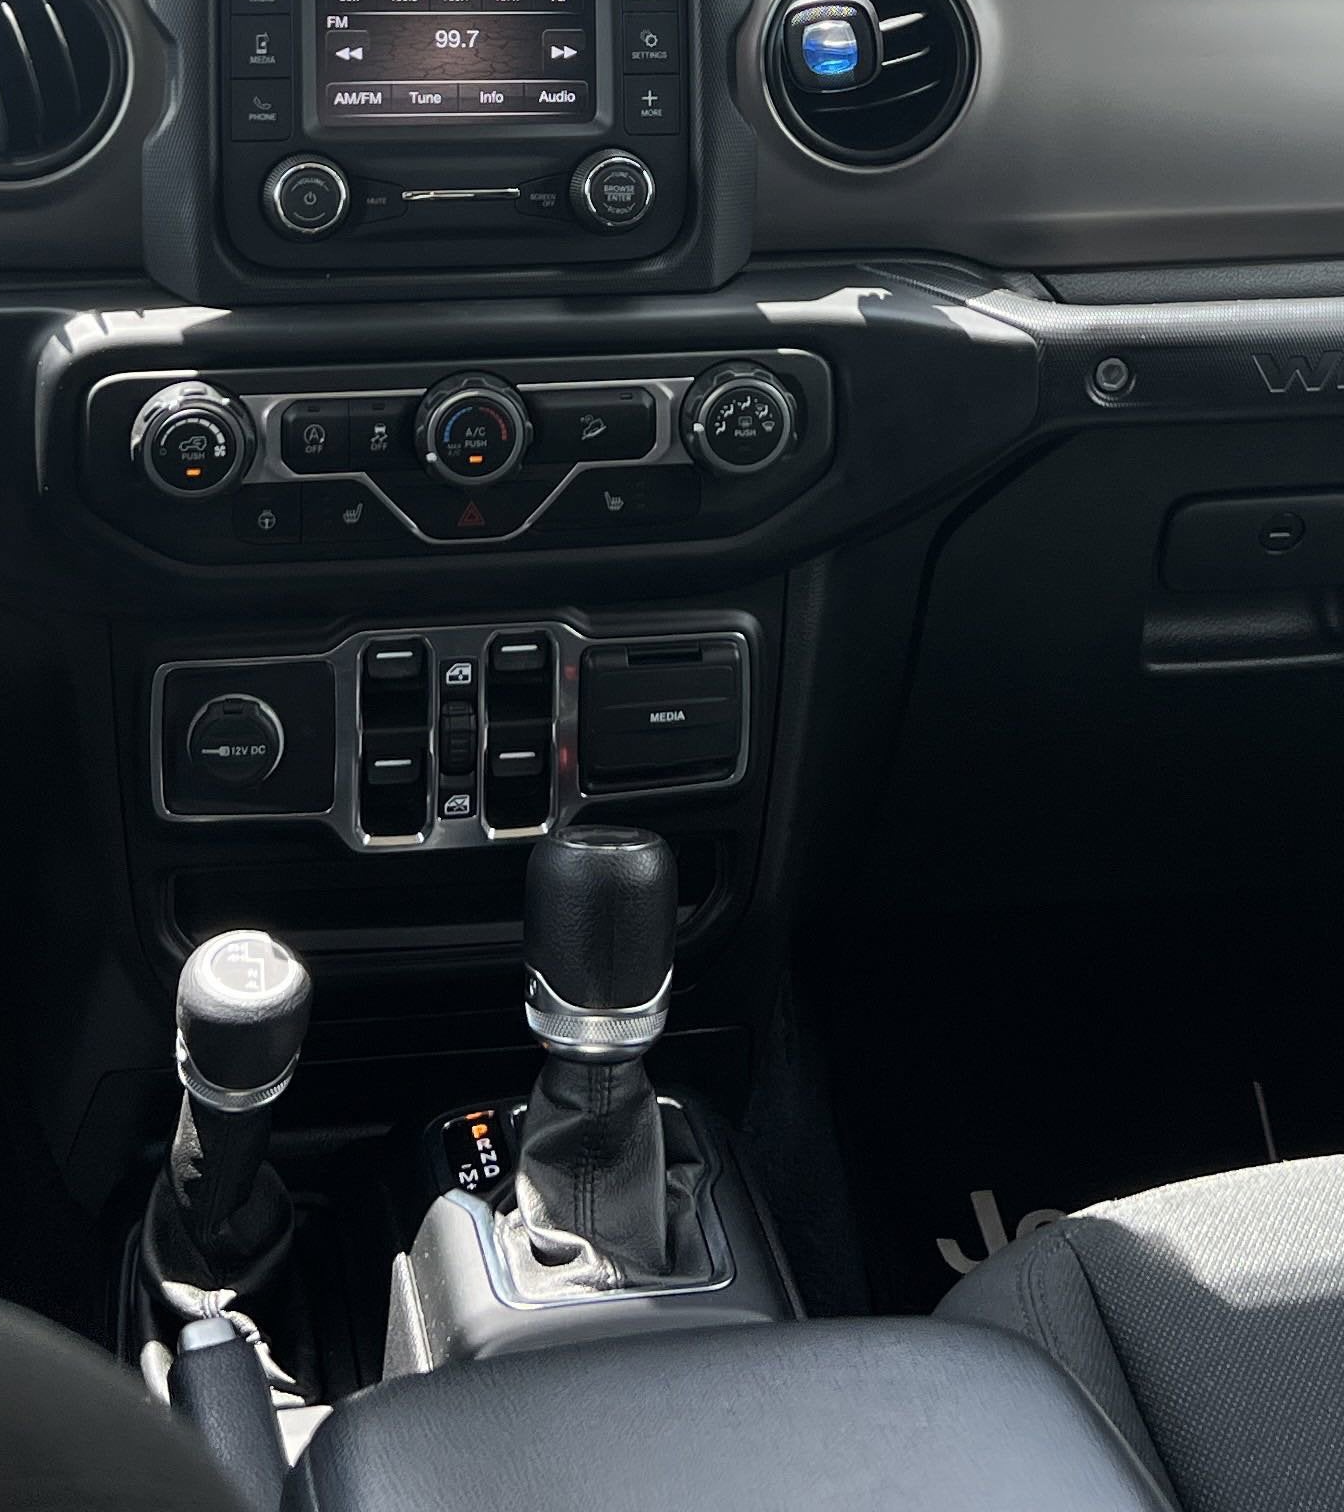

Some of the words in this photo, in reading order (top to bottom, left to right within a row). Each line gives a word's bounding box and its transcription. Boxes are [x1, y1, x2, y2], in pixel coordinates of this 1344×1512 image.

[327, 16, 348, 29] FM
[435, 30, 480, 48] 99.7
[249, 55, 276, 65] MEDIA
[631, 51, 668, 60] SETTINGS
[334, 91, 382, 105] AM/FM
[409, 91, 442, 105] Tune
[479, 91, 504, 104] Info
[539, 90, 576, 103] Audio
[248, 112, 277, 121] PHONE
[641, 109, 663, 117] MORE
[607, 194, 632, 202] ENTER
[465, 427, 486, 437] A/C
[734, 429, 757, 437] PUSH
[370, 442, 388, 451] OFF
[464, 439, 488, 448] PUSH
[305, 445, 323, 454] OFF
[181, 451, 206, 461] PUSH
[650, 711, 685, 723] MEDIA
[230, 745, 249, 756] 12V
[250, 745, 266, 756] DC
[472, 1124, 488, 1139] P
[477, 1138, 492, 1151] R
[480, 1150, 497, 1164] N
[484, 1164, 500, 1178] D
[459, 1169, 478, 1184] M
